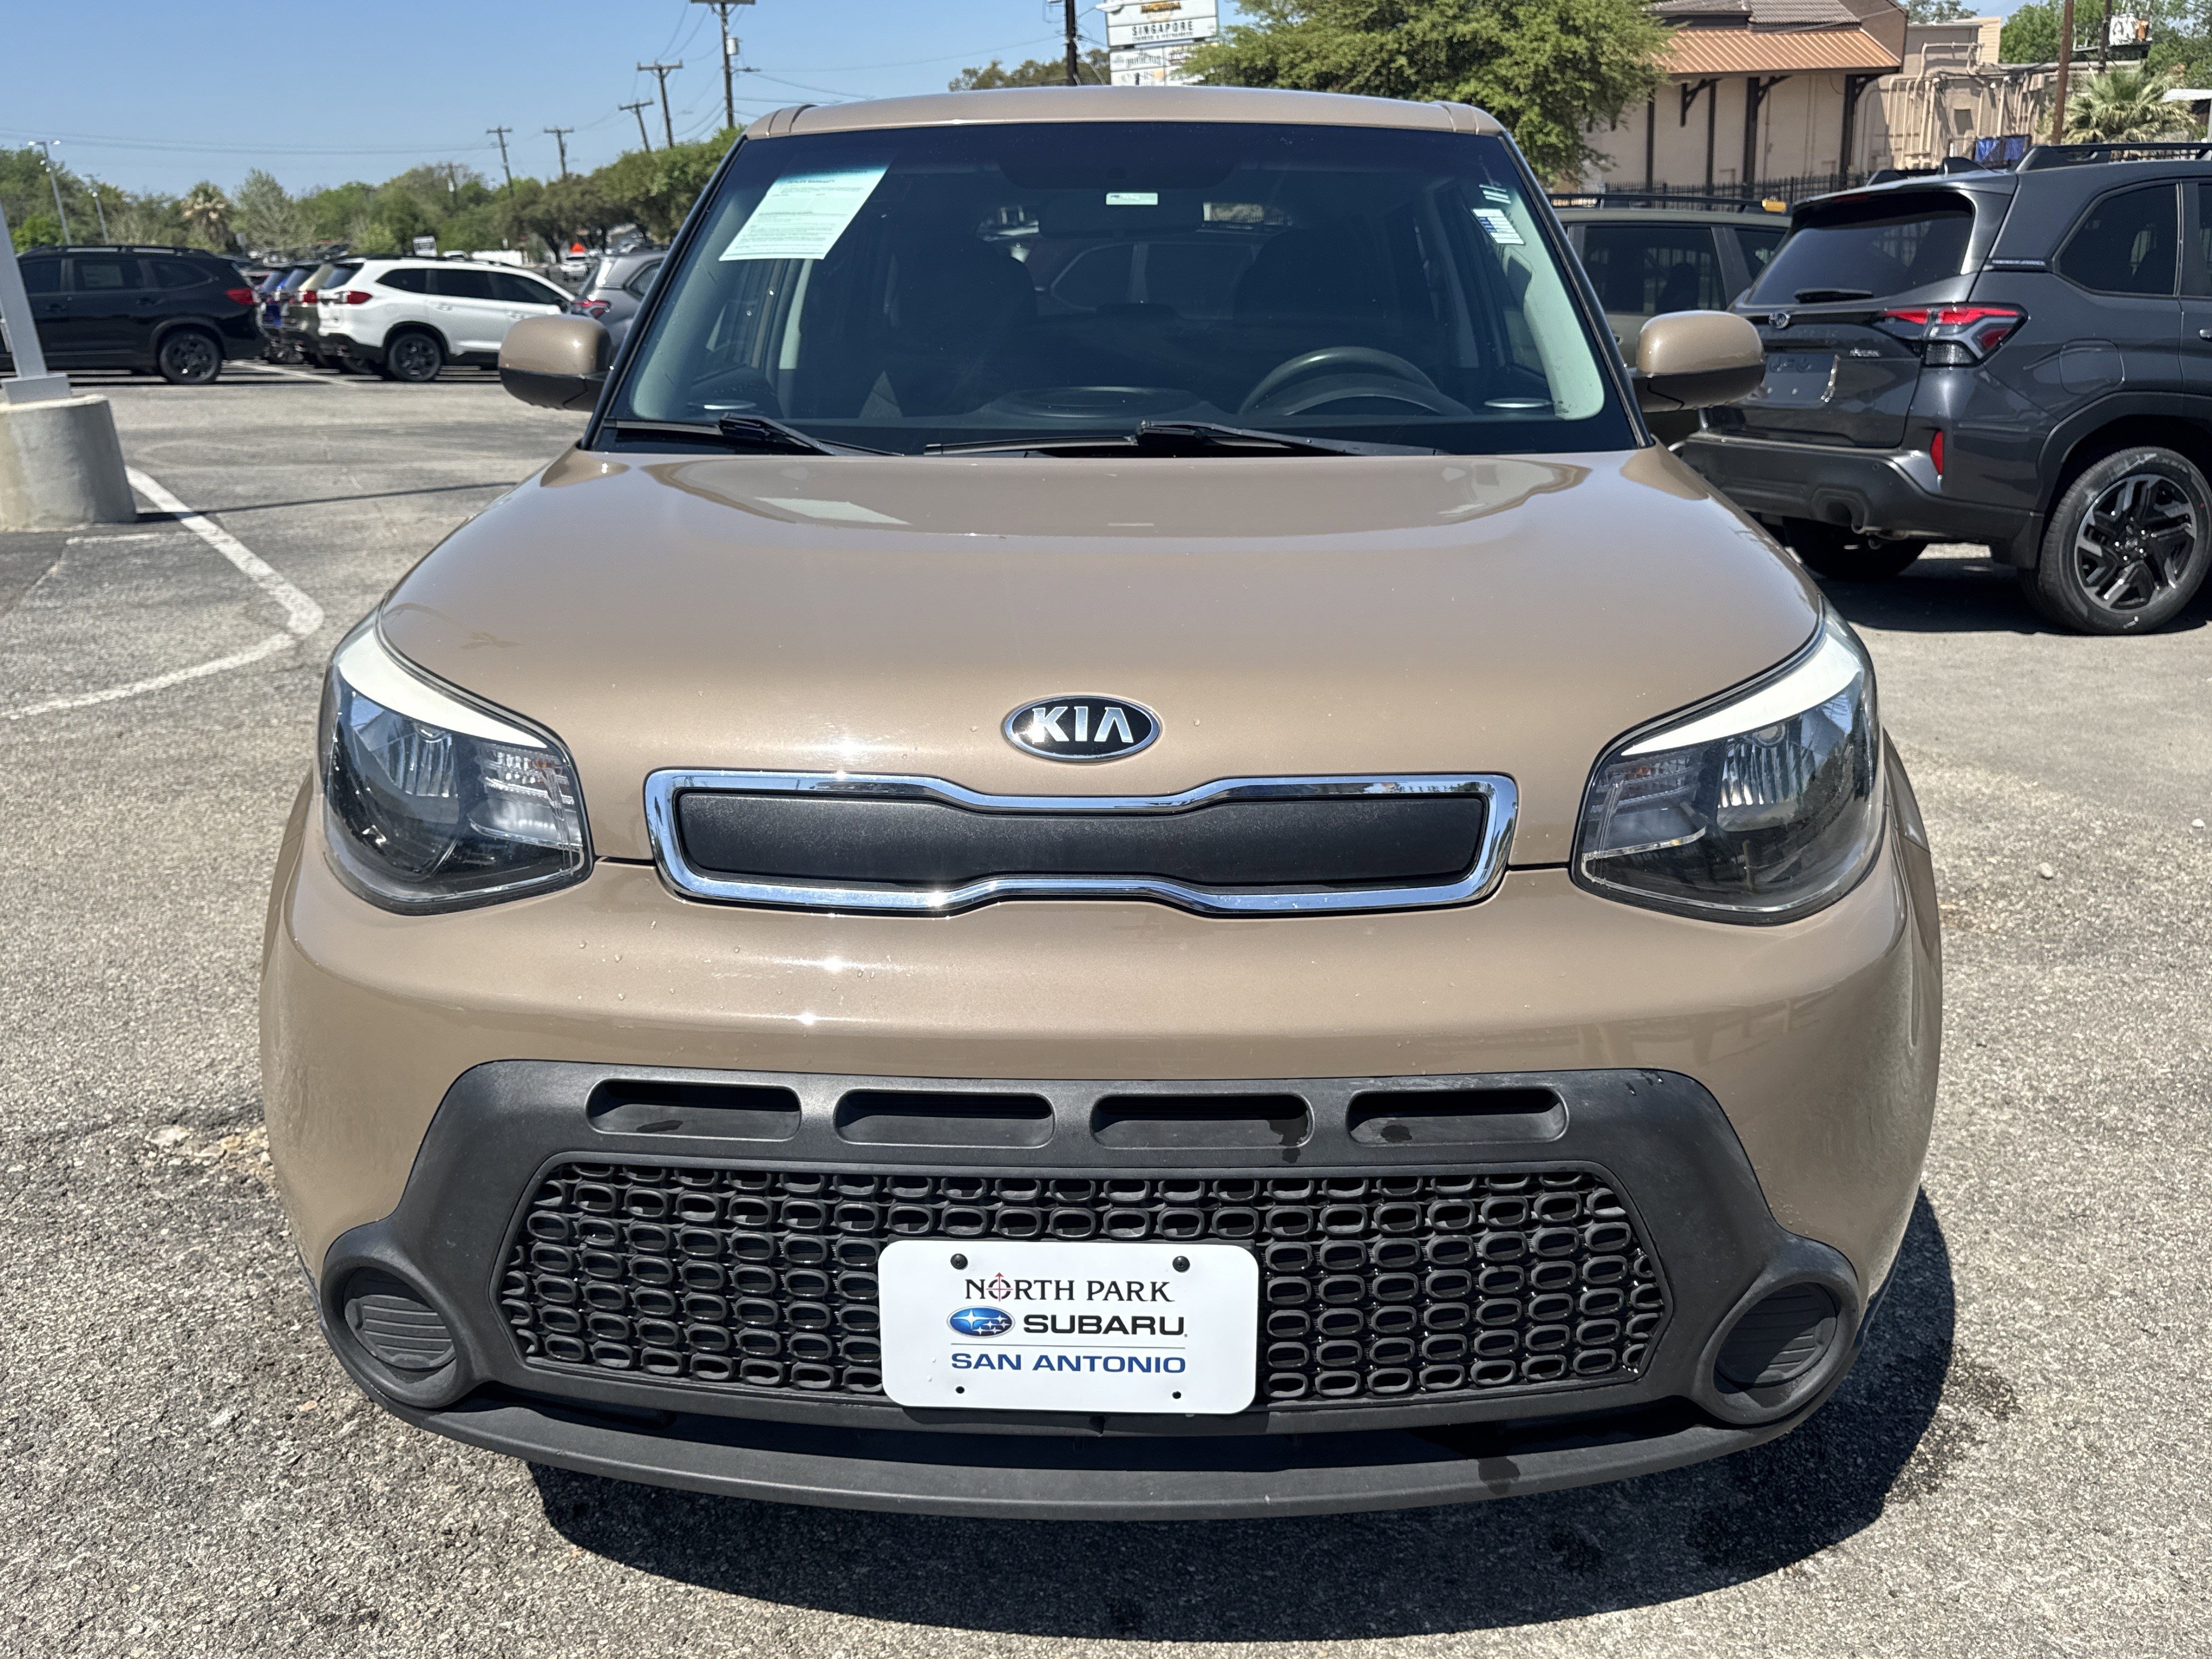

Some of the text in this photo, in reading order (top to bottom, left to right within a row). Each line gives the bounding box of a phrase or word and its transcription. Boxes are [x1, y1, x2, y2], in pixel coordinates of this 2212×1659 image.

[1132, 21, 1193, 36] SINGAPORE
[1032, 706, 1134, 743] KIA
[964, 1276, 1174, 1302] NORTH PARK
[1023, 1314, 1185, 1336] SUBARU
[951, 1352, 1186, 1374] SAN ANTONIO
